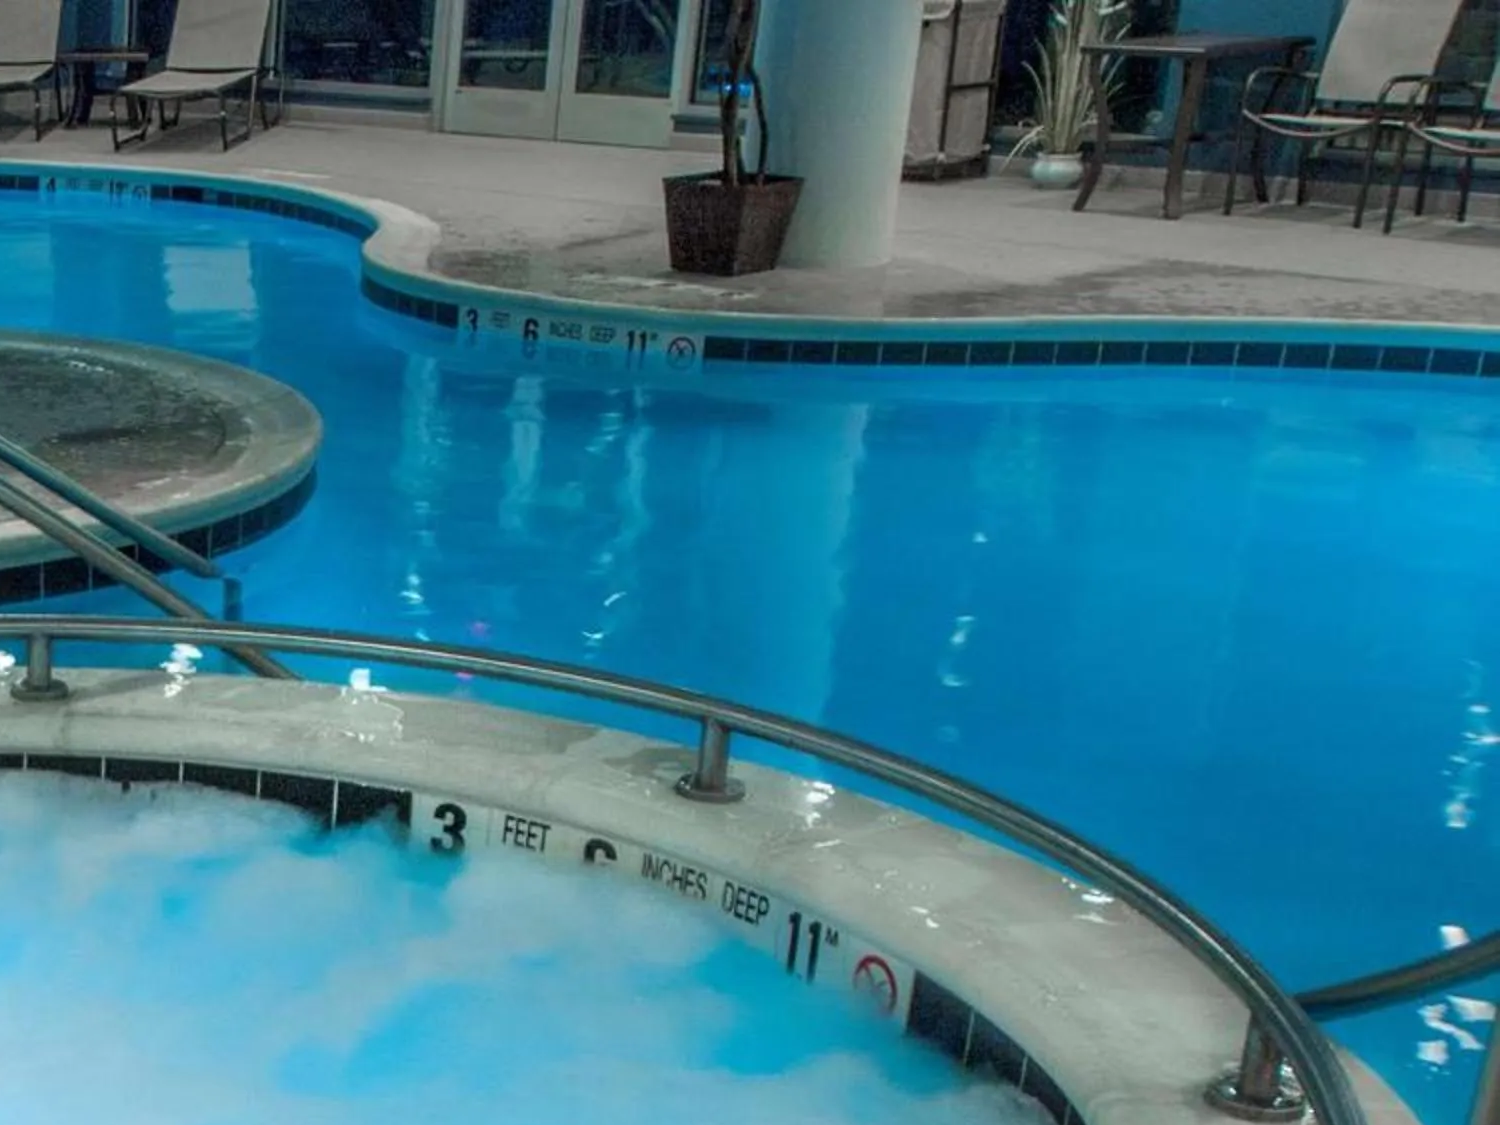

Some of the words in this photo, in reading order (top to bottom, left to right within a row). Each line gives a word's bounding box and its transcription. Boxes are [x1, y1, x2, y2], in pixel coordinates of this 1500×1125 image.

[430, 803, 467, 855] 3
[502, 815, 552, 853] FEET
[641, 853, 708, 900] INCHES
[722, 881, 770, 925] DEEP
